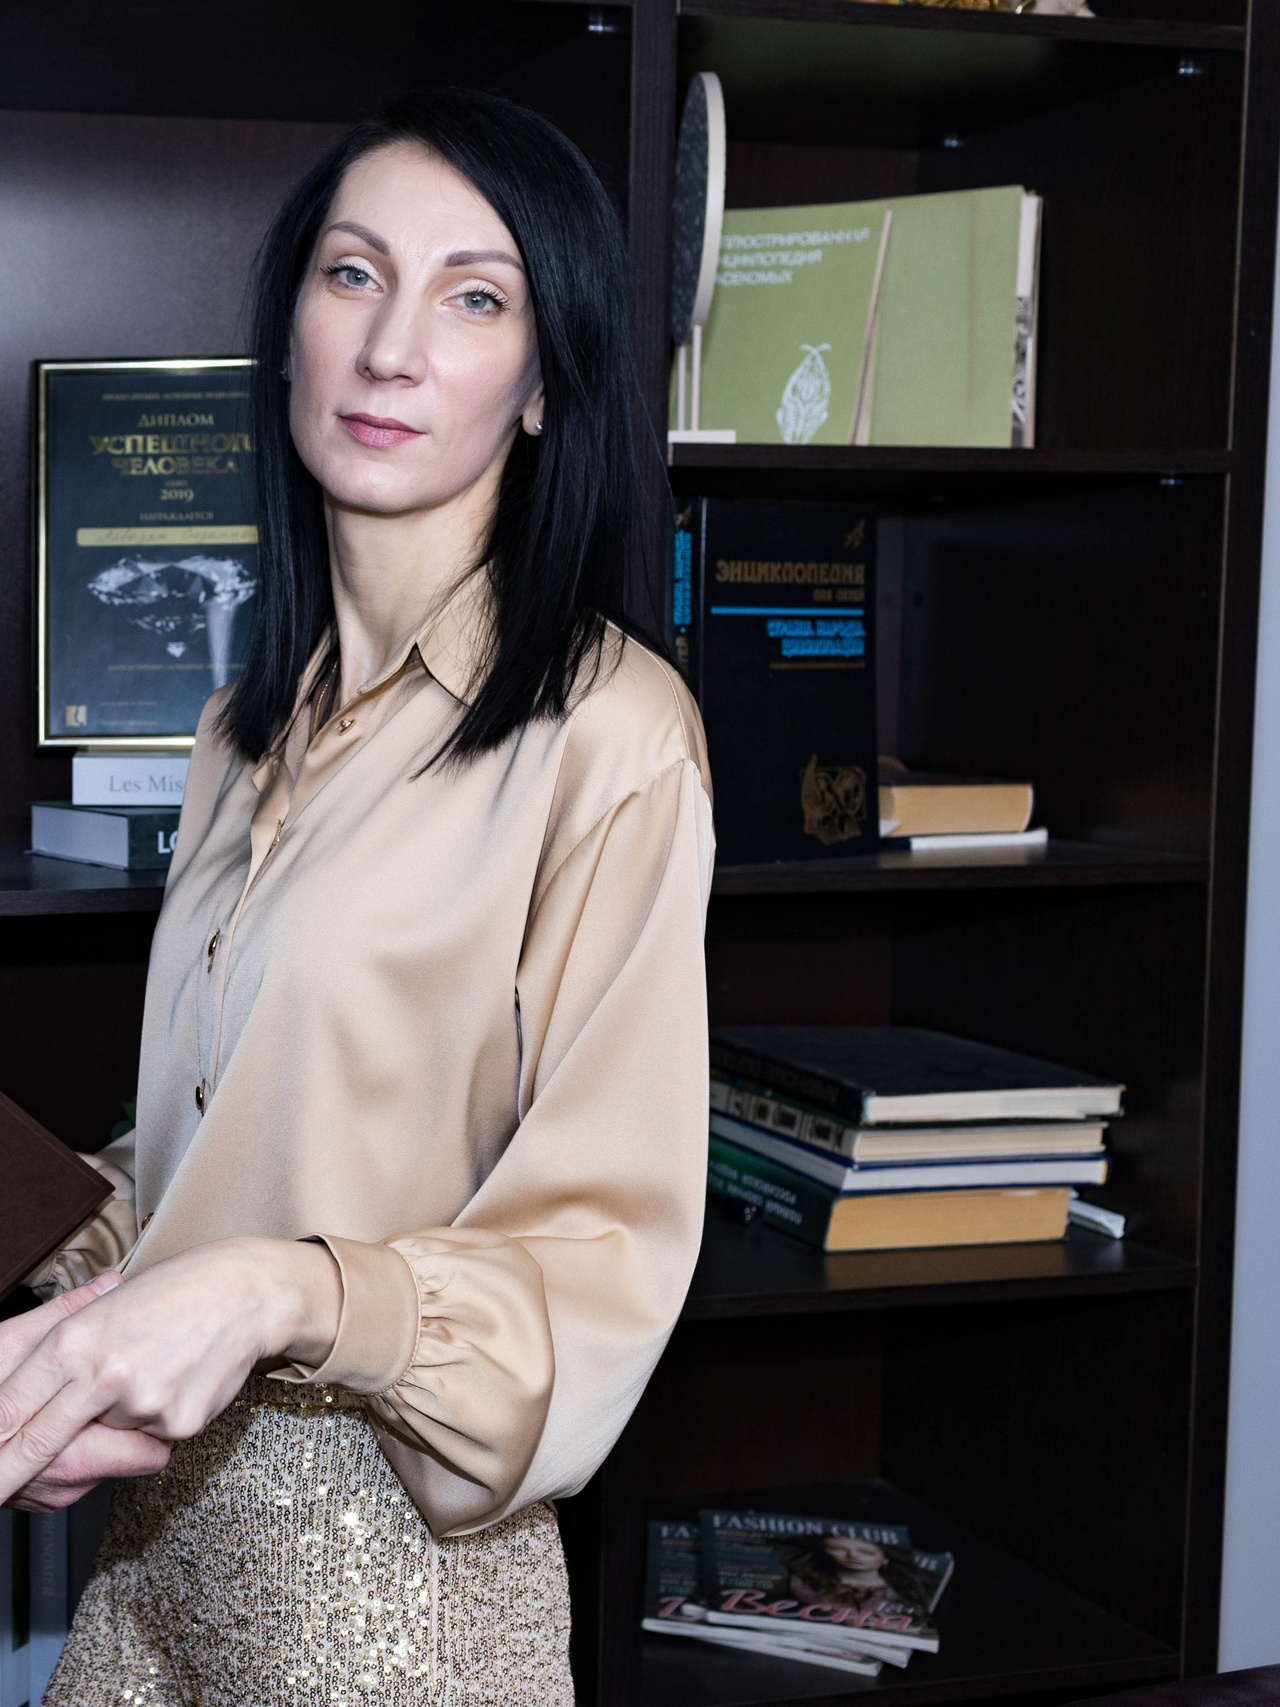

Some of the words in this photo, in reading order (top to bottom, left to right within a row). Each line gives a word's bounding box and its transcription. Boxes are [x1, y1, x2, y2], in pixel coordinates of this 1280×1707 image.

[720, 249, 823, 268] ЦИКЛОПЕДИЯ
[716, 269, 794, 287] АСЕКОМЫХ
[137, 413, 214, 428] ДИПЛОМ
[111, 456, 239, 476] ЧЕЛОВЕКА
[160, 489, 194, 503] 2019
[715, 559, 866, 585] ЭНЦИКЛОПЕДИЯ
[109, 775, 141, 793] Les
[148, 775, 184, 793] Mis
[712, 1513, 823, 1536] FASHION
[830, 1524, 899, 1546] CLUB
[720, 1588, 922, 1633] Весна
